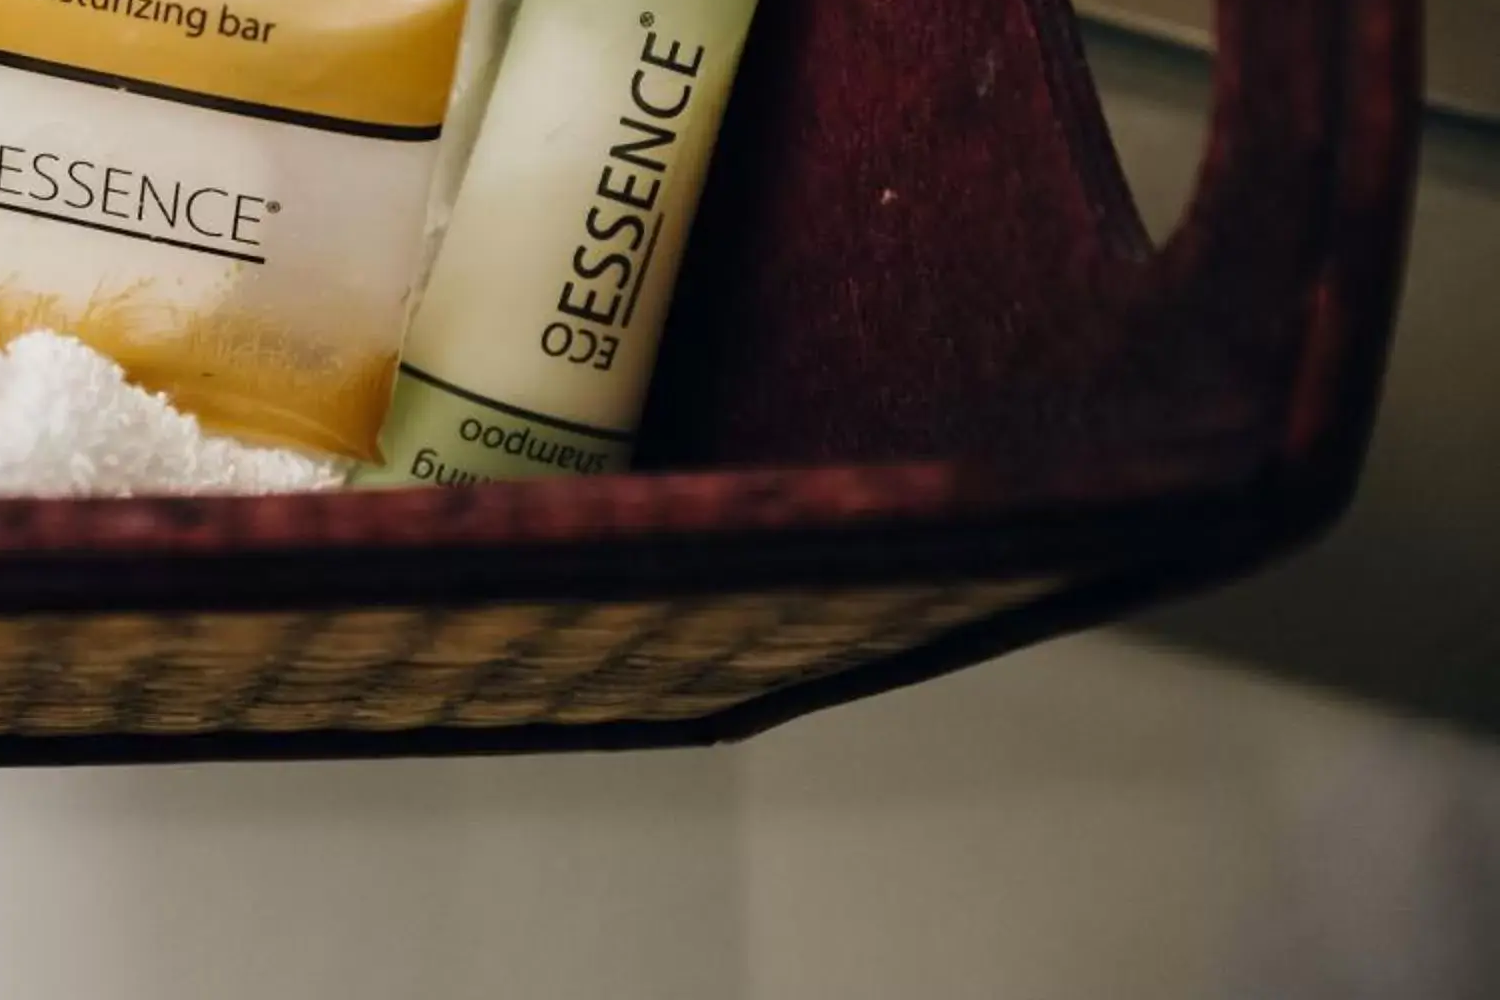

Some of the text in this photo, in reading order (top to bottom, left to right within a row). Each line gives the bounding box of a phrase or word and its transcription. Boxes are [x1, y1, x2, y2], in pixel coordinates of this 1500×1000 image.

[217, 6, 275, 44] bar
[557, 32, 704, 326] ESSENCE
[540, 322, 621, 371] ECO
[458, 417, 608, 476] shampoo
